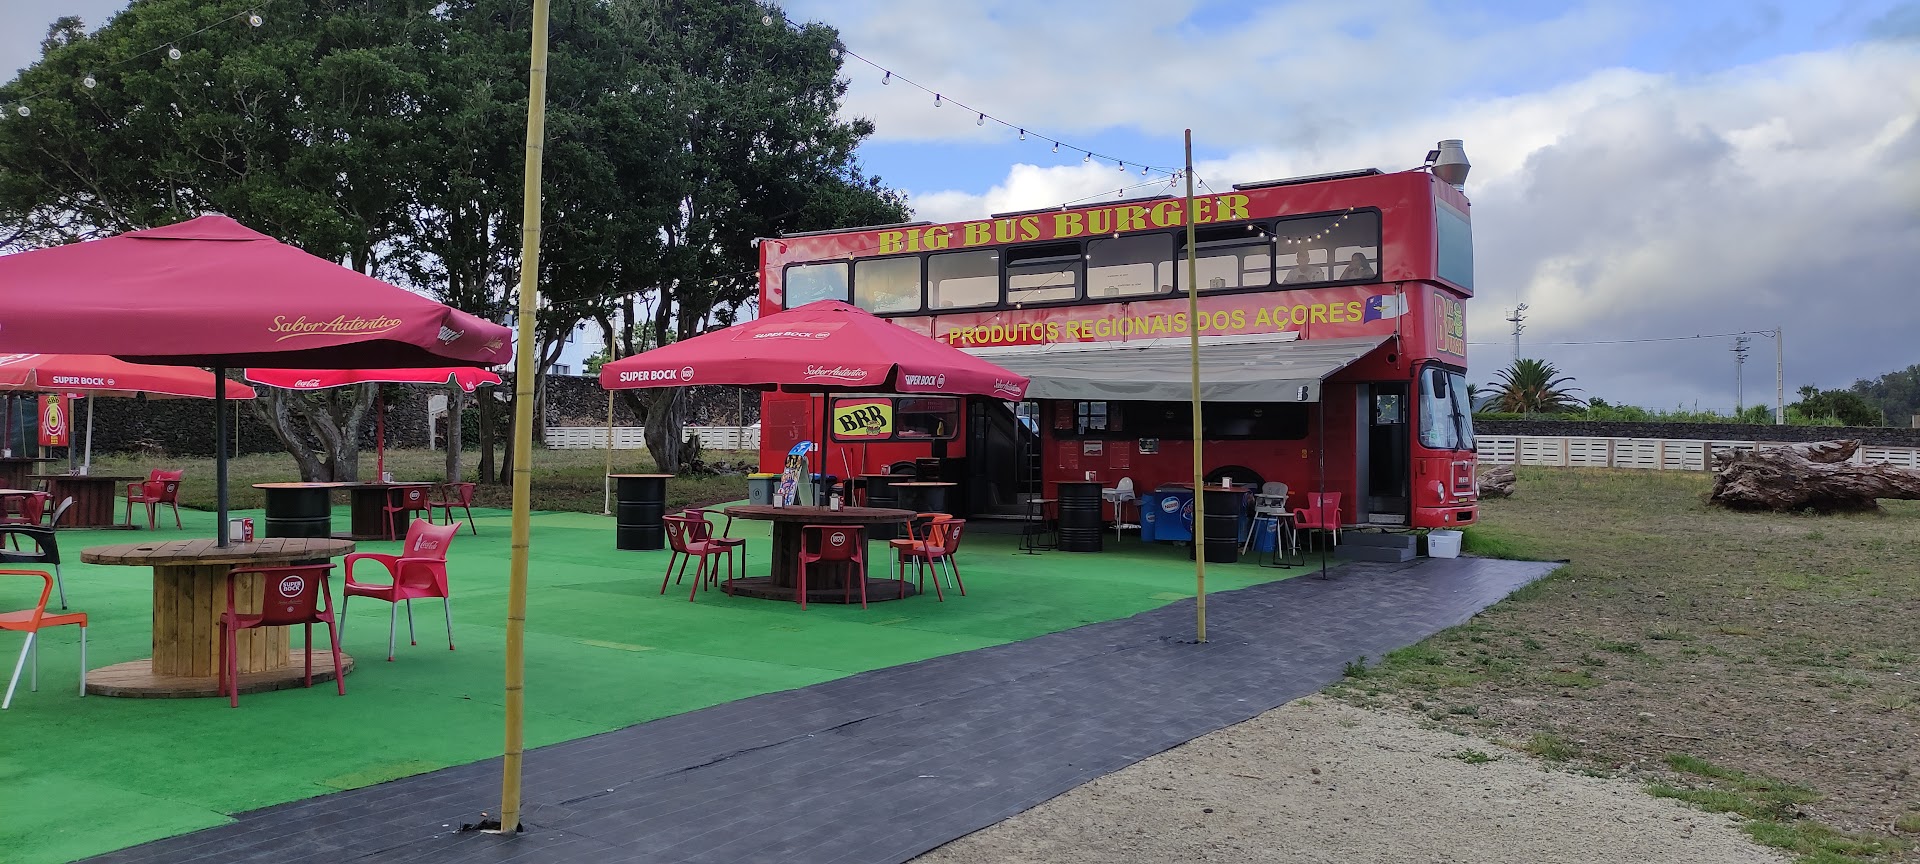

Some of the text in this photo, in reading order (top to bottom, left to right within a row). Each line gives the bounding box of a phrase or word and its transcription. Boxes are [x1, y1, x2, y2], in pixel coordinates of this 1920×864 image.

[877, 194, 1252, 256] BIG BUS BURGER
[268, 315, 322, 333] Sabor
[949, 301, 1363, 346] PRODUTOS REGIONAIS DOS AÇORES
[752, 331, 783, 339] SUPER
[619, 370, 650, 383] SUPER
[650, 369, 678, 381] BOCK
[803, 364, 831, 377] Sabor
[52, 376, 80, 386] SUPER
[80, 376, 105, 386] BOCK
[921, 375, 937, 386] BOCK
